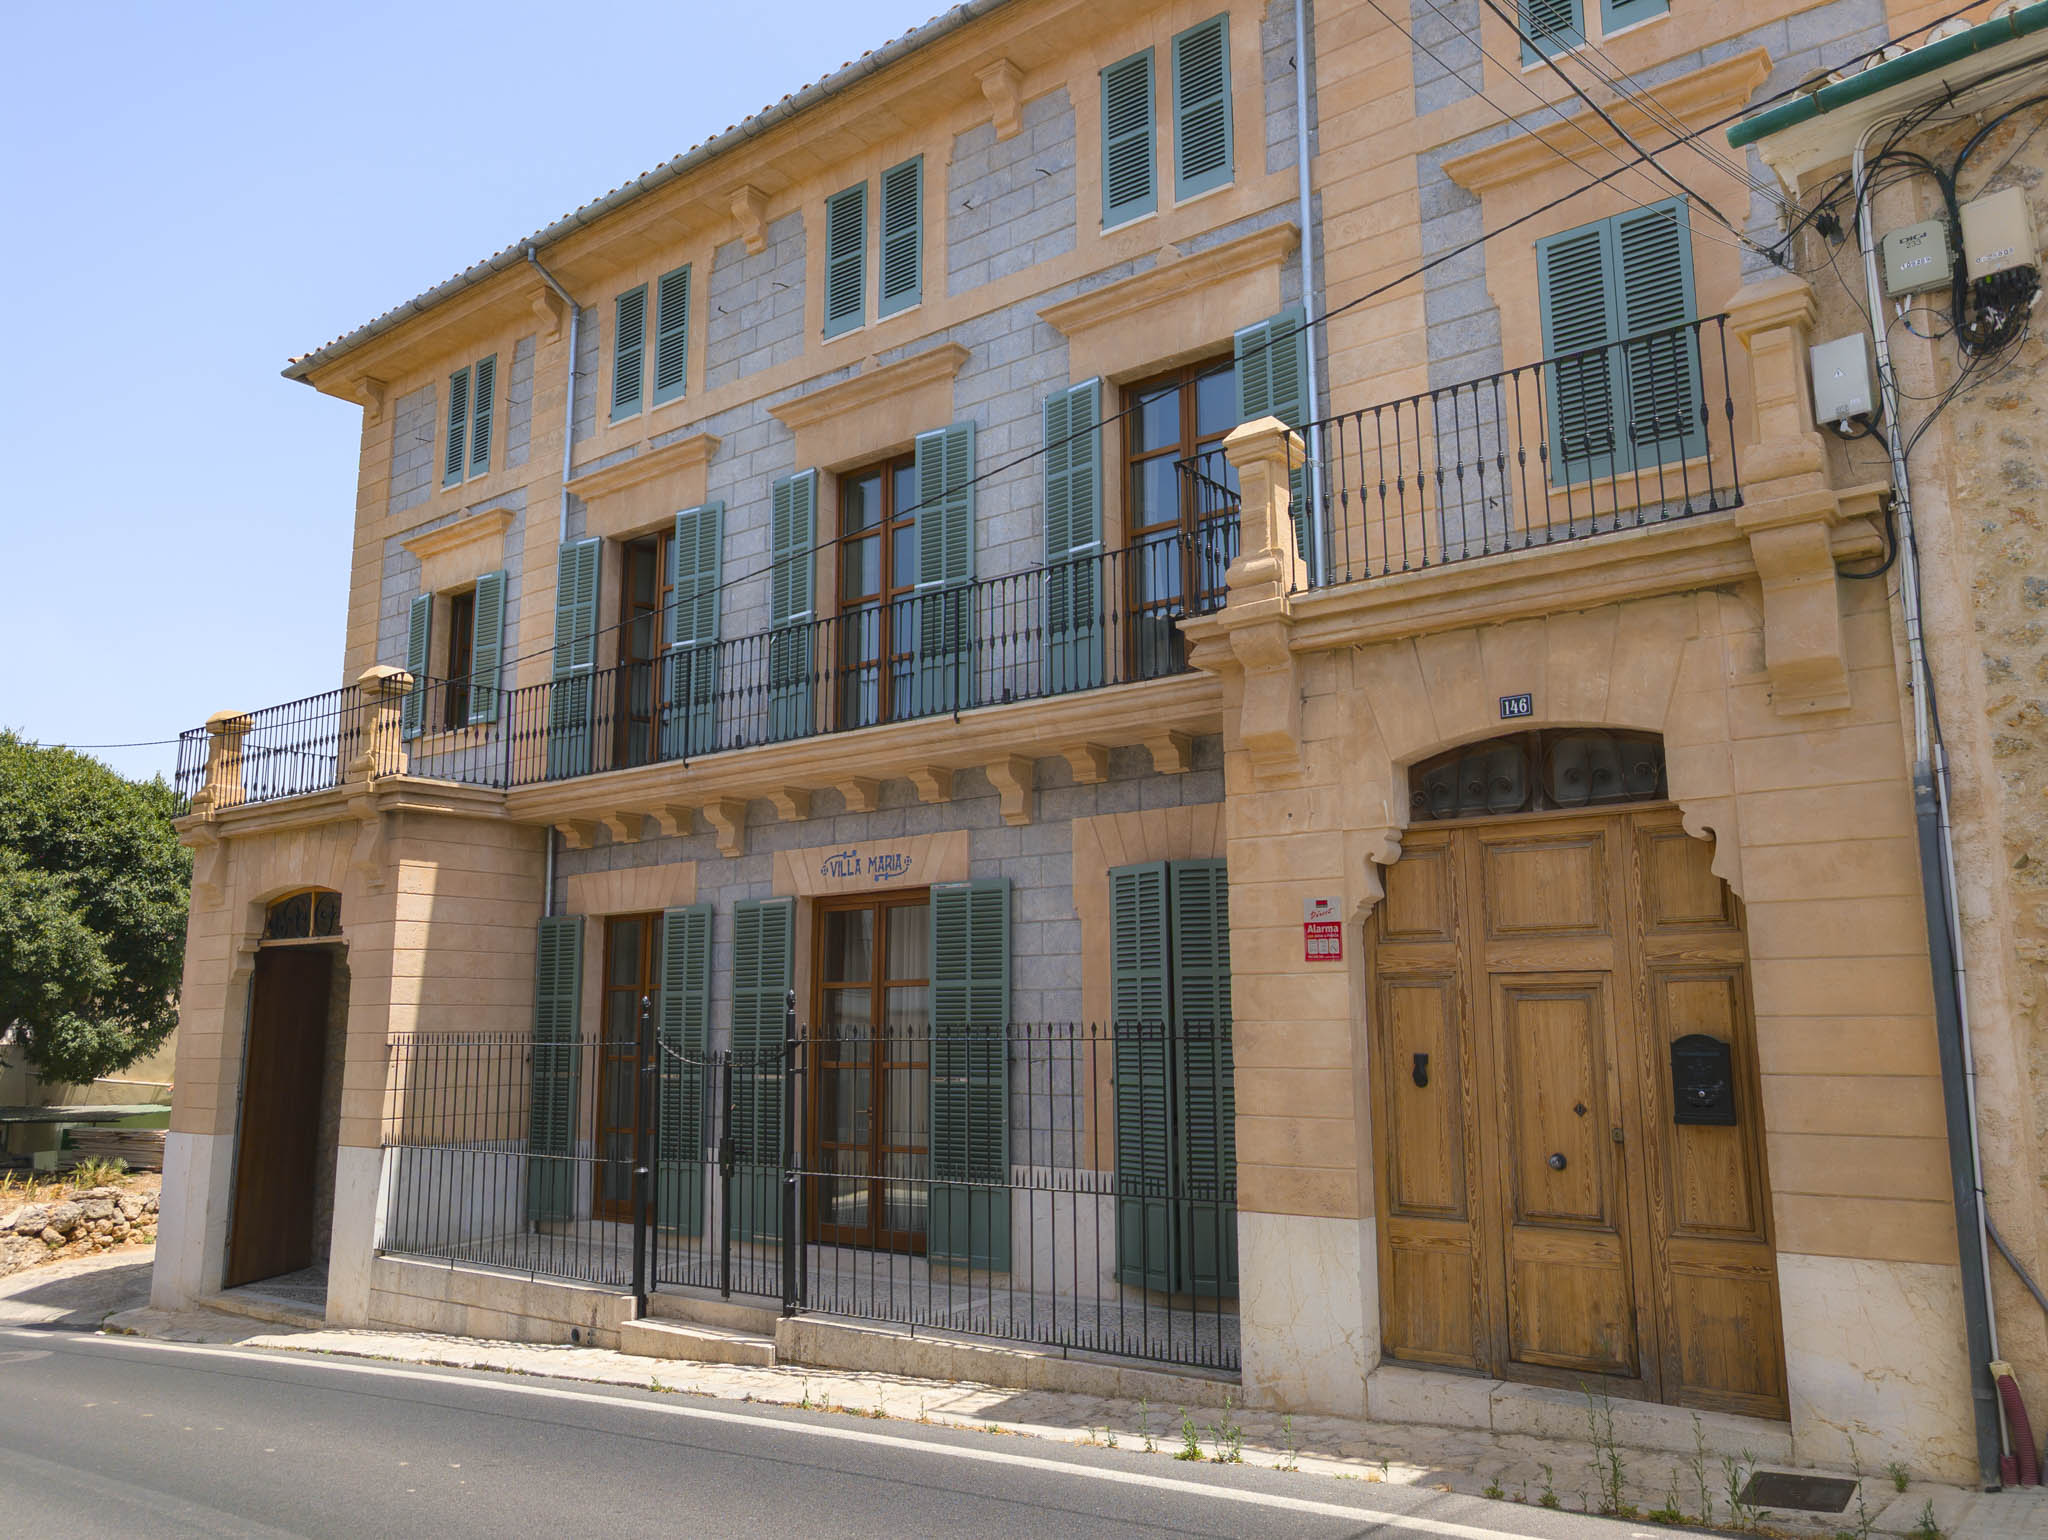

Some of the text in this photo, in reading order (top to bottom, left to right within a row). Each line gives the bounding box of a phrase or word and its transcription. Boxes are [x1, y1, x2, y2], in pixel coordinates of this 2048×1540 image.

[1504, 698, 1527, 715] 146
[830, 853, 902, 877] VILLA MARIA
[1307, 924, 1339, 933] Alarma
